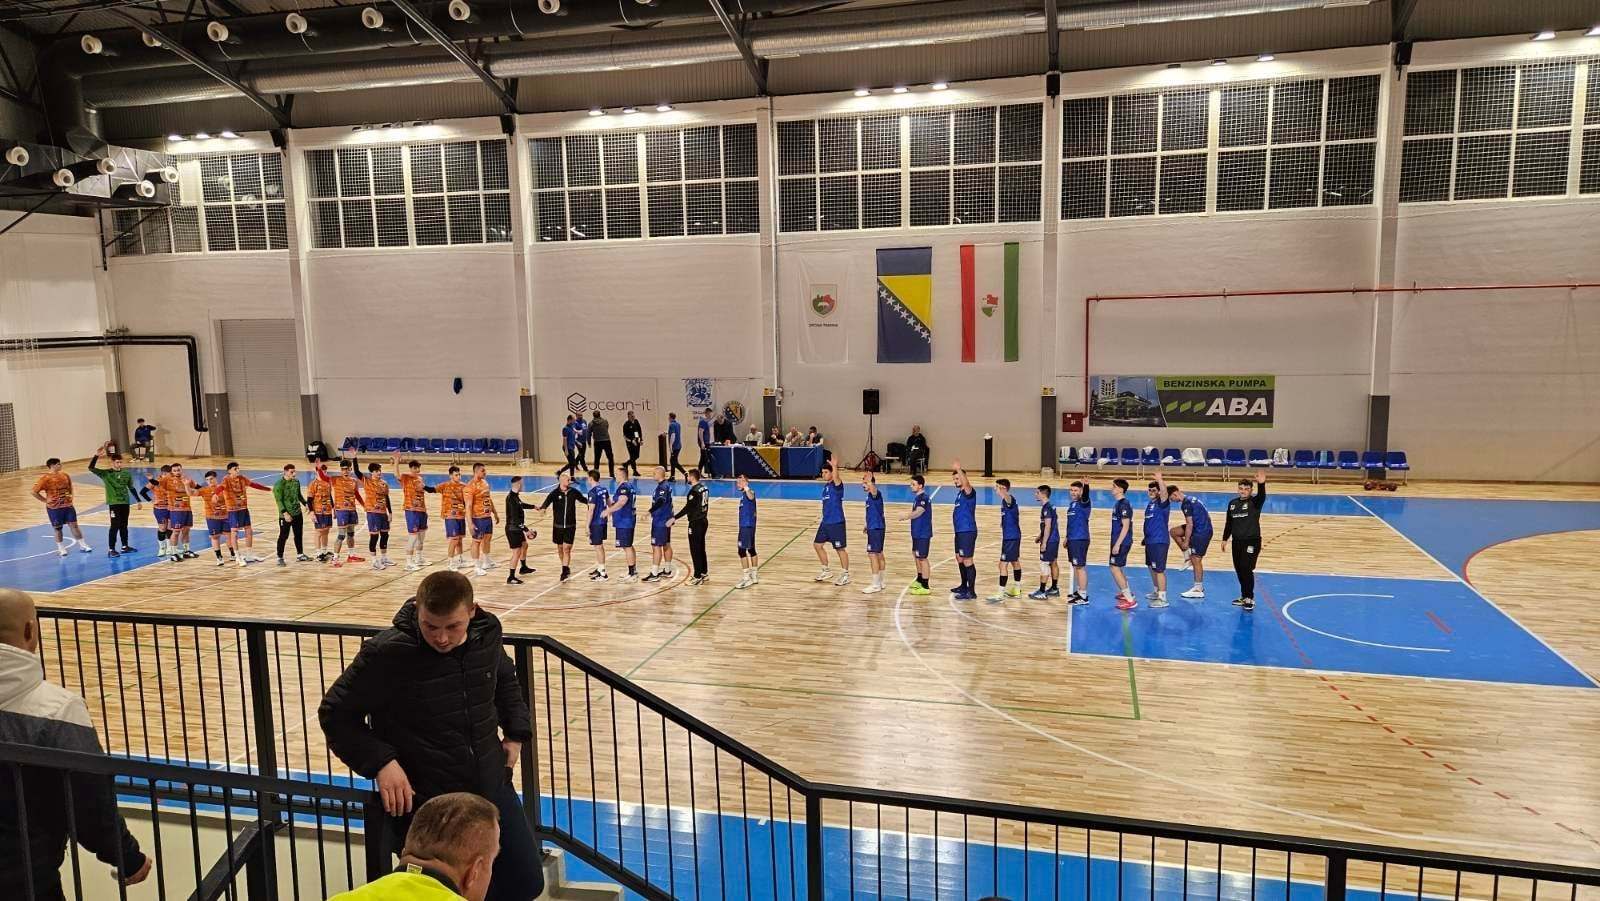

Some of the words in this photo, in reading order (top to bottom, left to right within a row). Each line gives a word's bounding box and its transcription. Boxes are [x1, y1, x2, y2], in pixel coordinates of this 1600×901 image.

[1163, 379, 1226, 388] BENZINSKA
[1228, 379, 1267, 388] PUMPA
[588, 398, 651, 411] ocean-it
[1205, 397, 1268, 416] ABA
